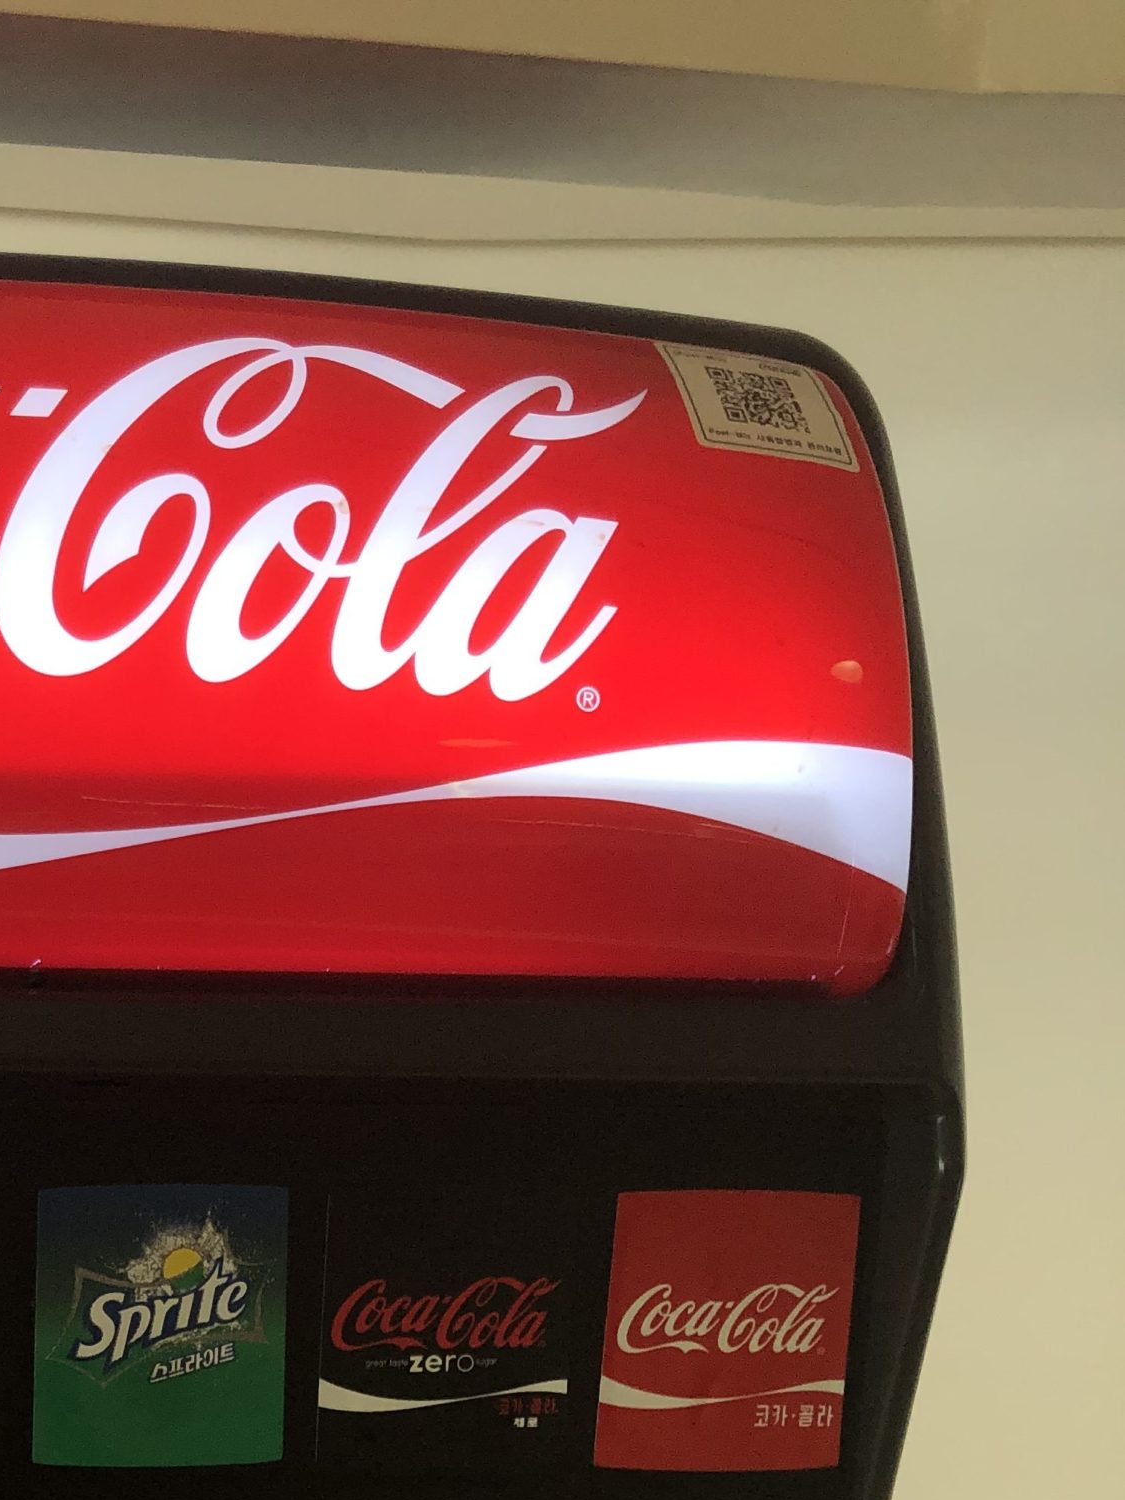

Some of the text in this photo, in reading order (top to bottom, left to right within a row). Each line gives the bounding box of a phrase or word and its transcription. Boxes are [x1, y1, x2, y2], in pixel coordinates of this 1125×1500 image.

[74, 1261, 248, 1363] Sprite
[331, 1277, 562, 1352] Coca-Cola
[616, 1283, 840, 1355] Coca-Cola
[149, 1342, 235, 1383] 스프라이트
[409, 1354, 474, 1373] zero
